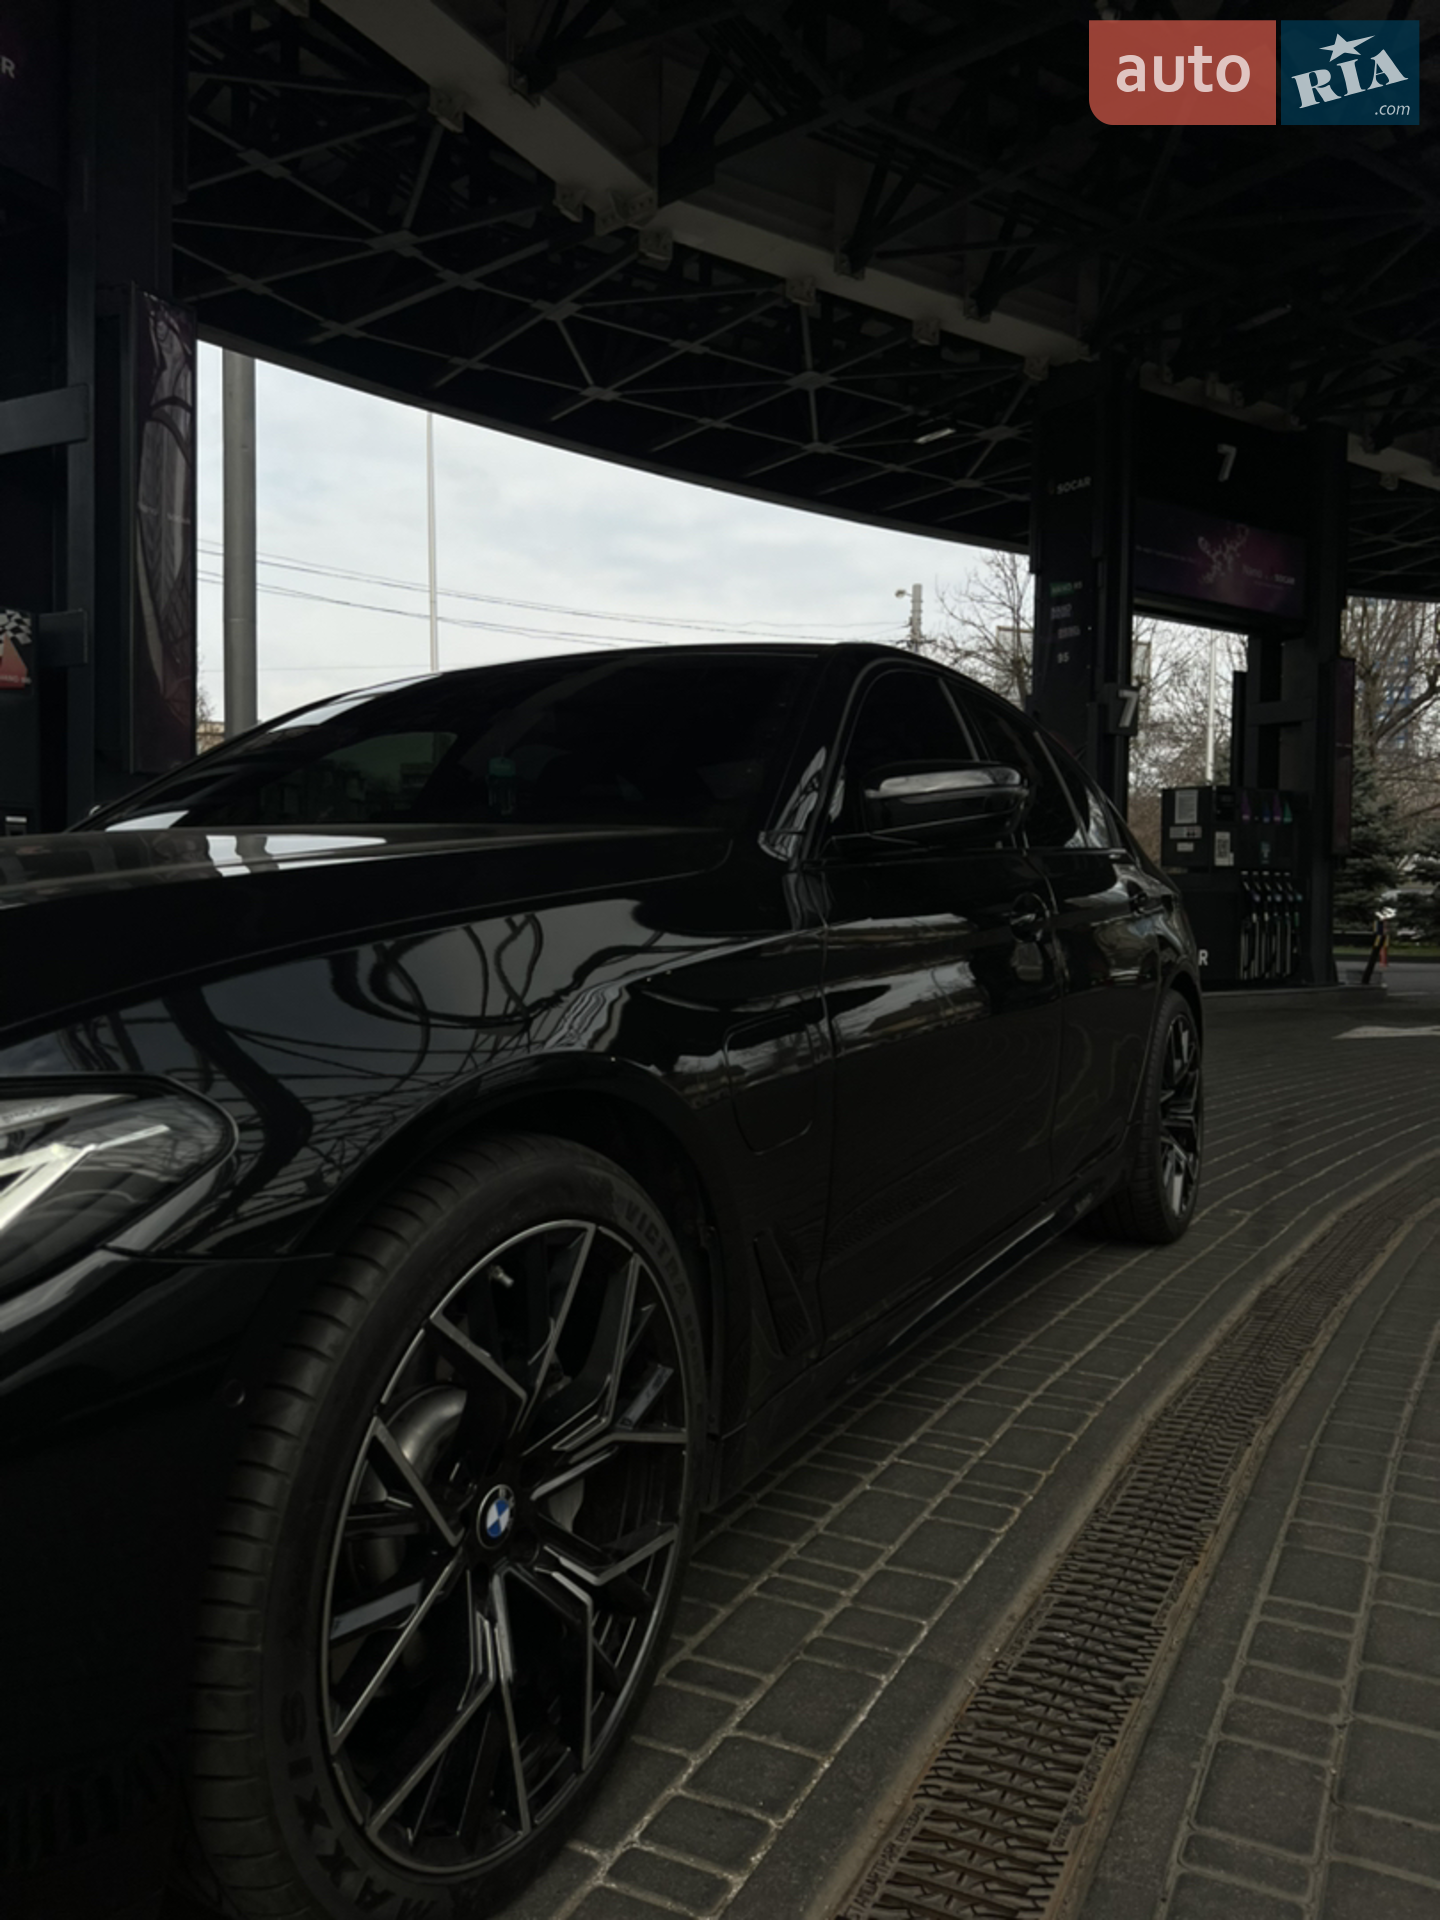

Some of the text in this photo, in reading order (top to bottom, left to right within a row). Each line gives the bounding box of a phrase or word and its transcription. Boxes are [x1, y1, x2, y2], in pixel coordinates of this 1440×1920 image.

[1216, 442, 1238, 483] 7
[1056, 475, 1092, 495] SOCAR
[1118, 689, 1138, 728] 7
